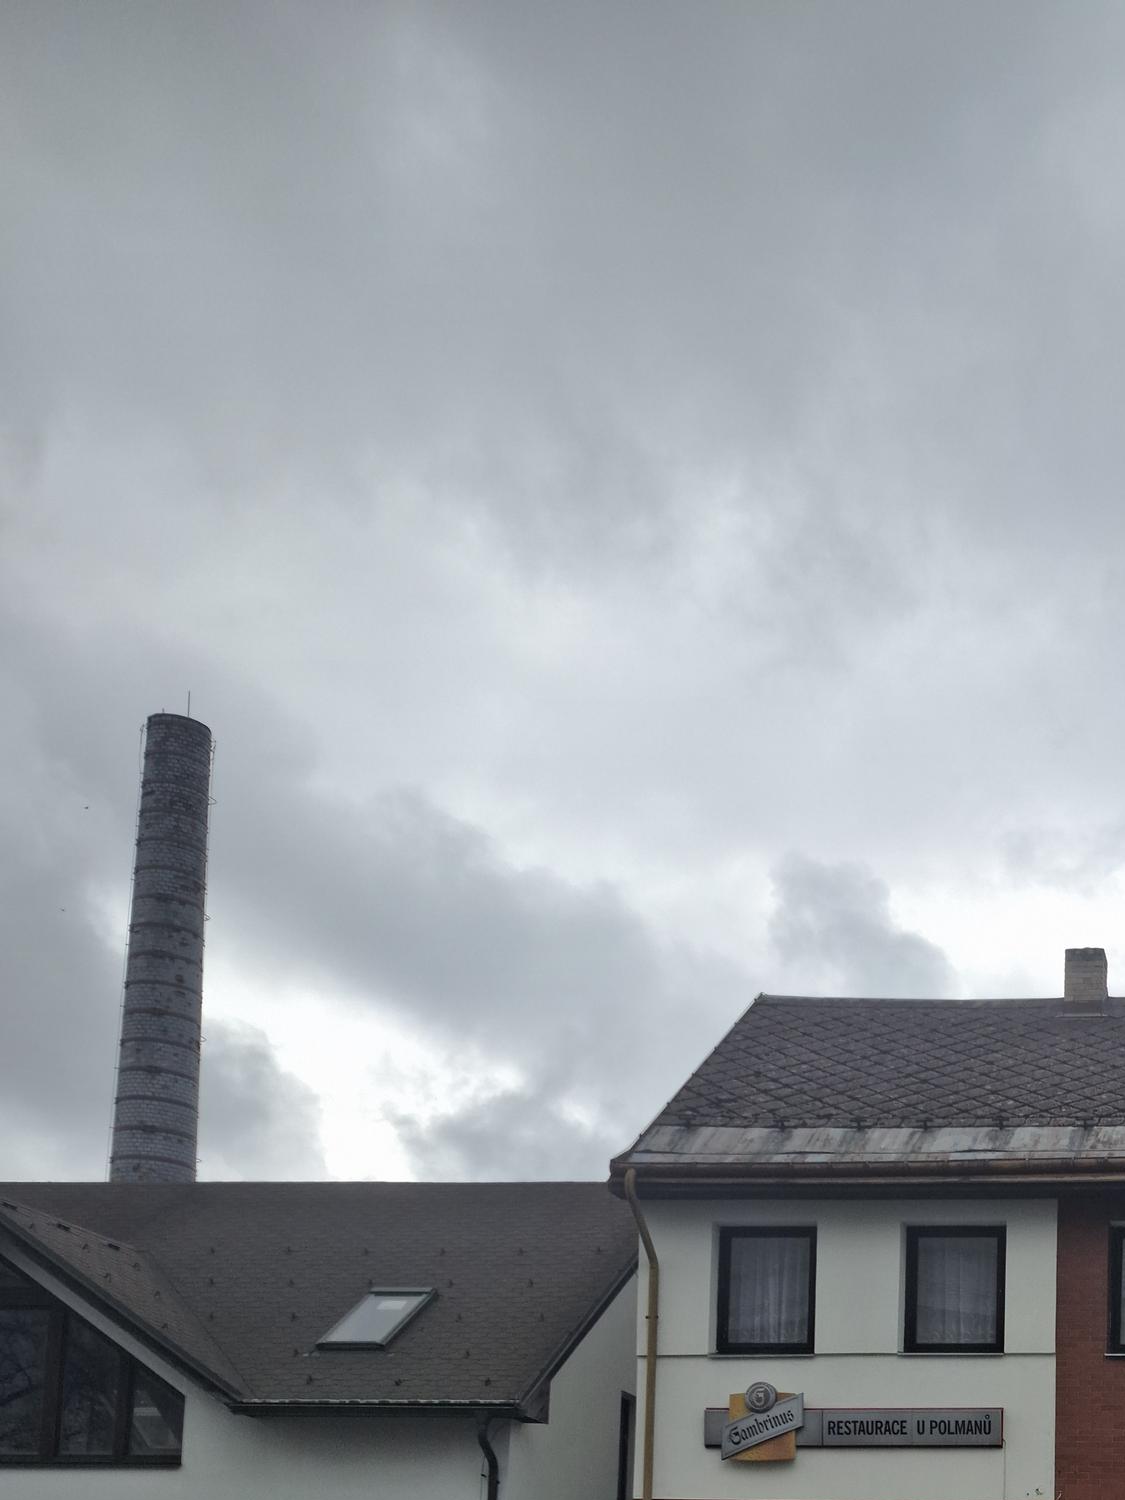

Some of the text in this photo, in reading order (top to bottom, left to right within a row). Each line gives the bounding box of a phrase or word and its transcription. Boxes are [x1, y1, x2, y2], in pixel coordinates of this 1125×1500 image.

[729, 1408, 795, 1446] Gambrinus
[827, 1414, 992, 1436] RESTAURACE U POLMANŮ
